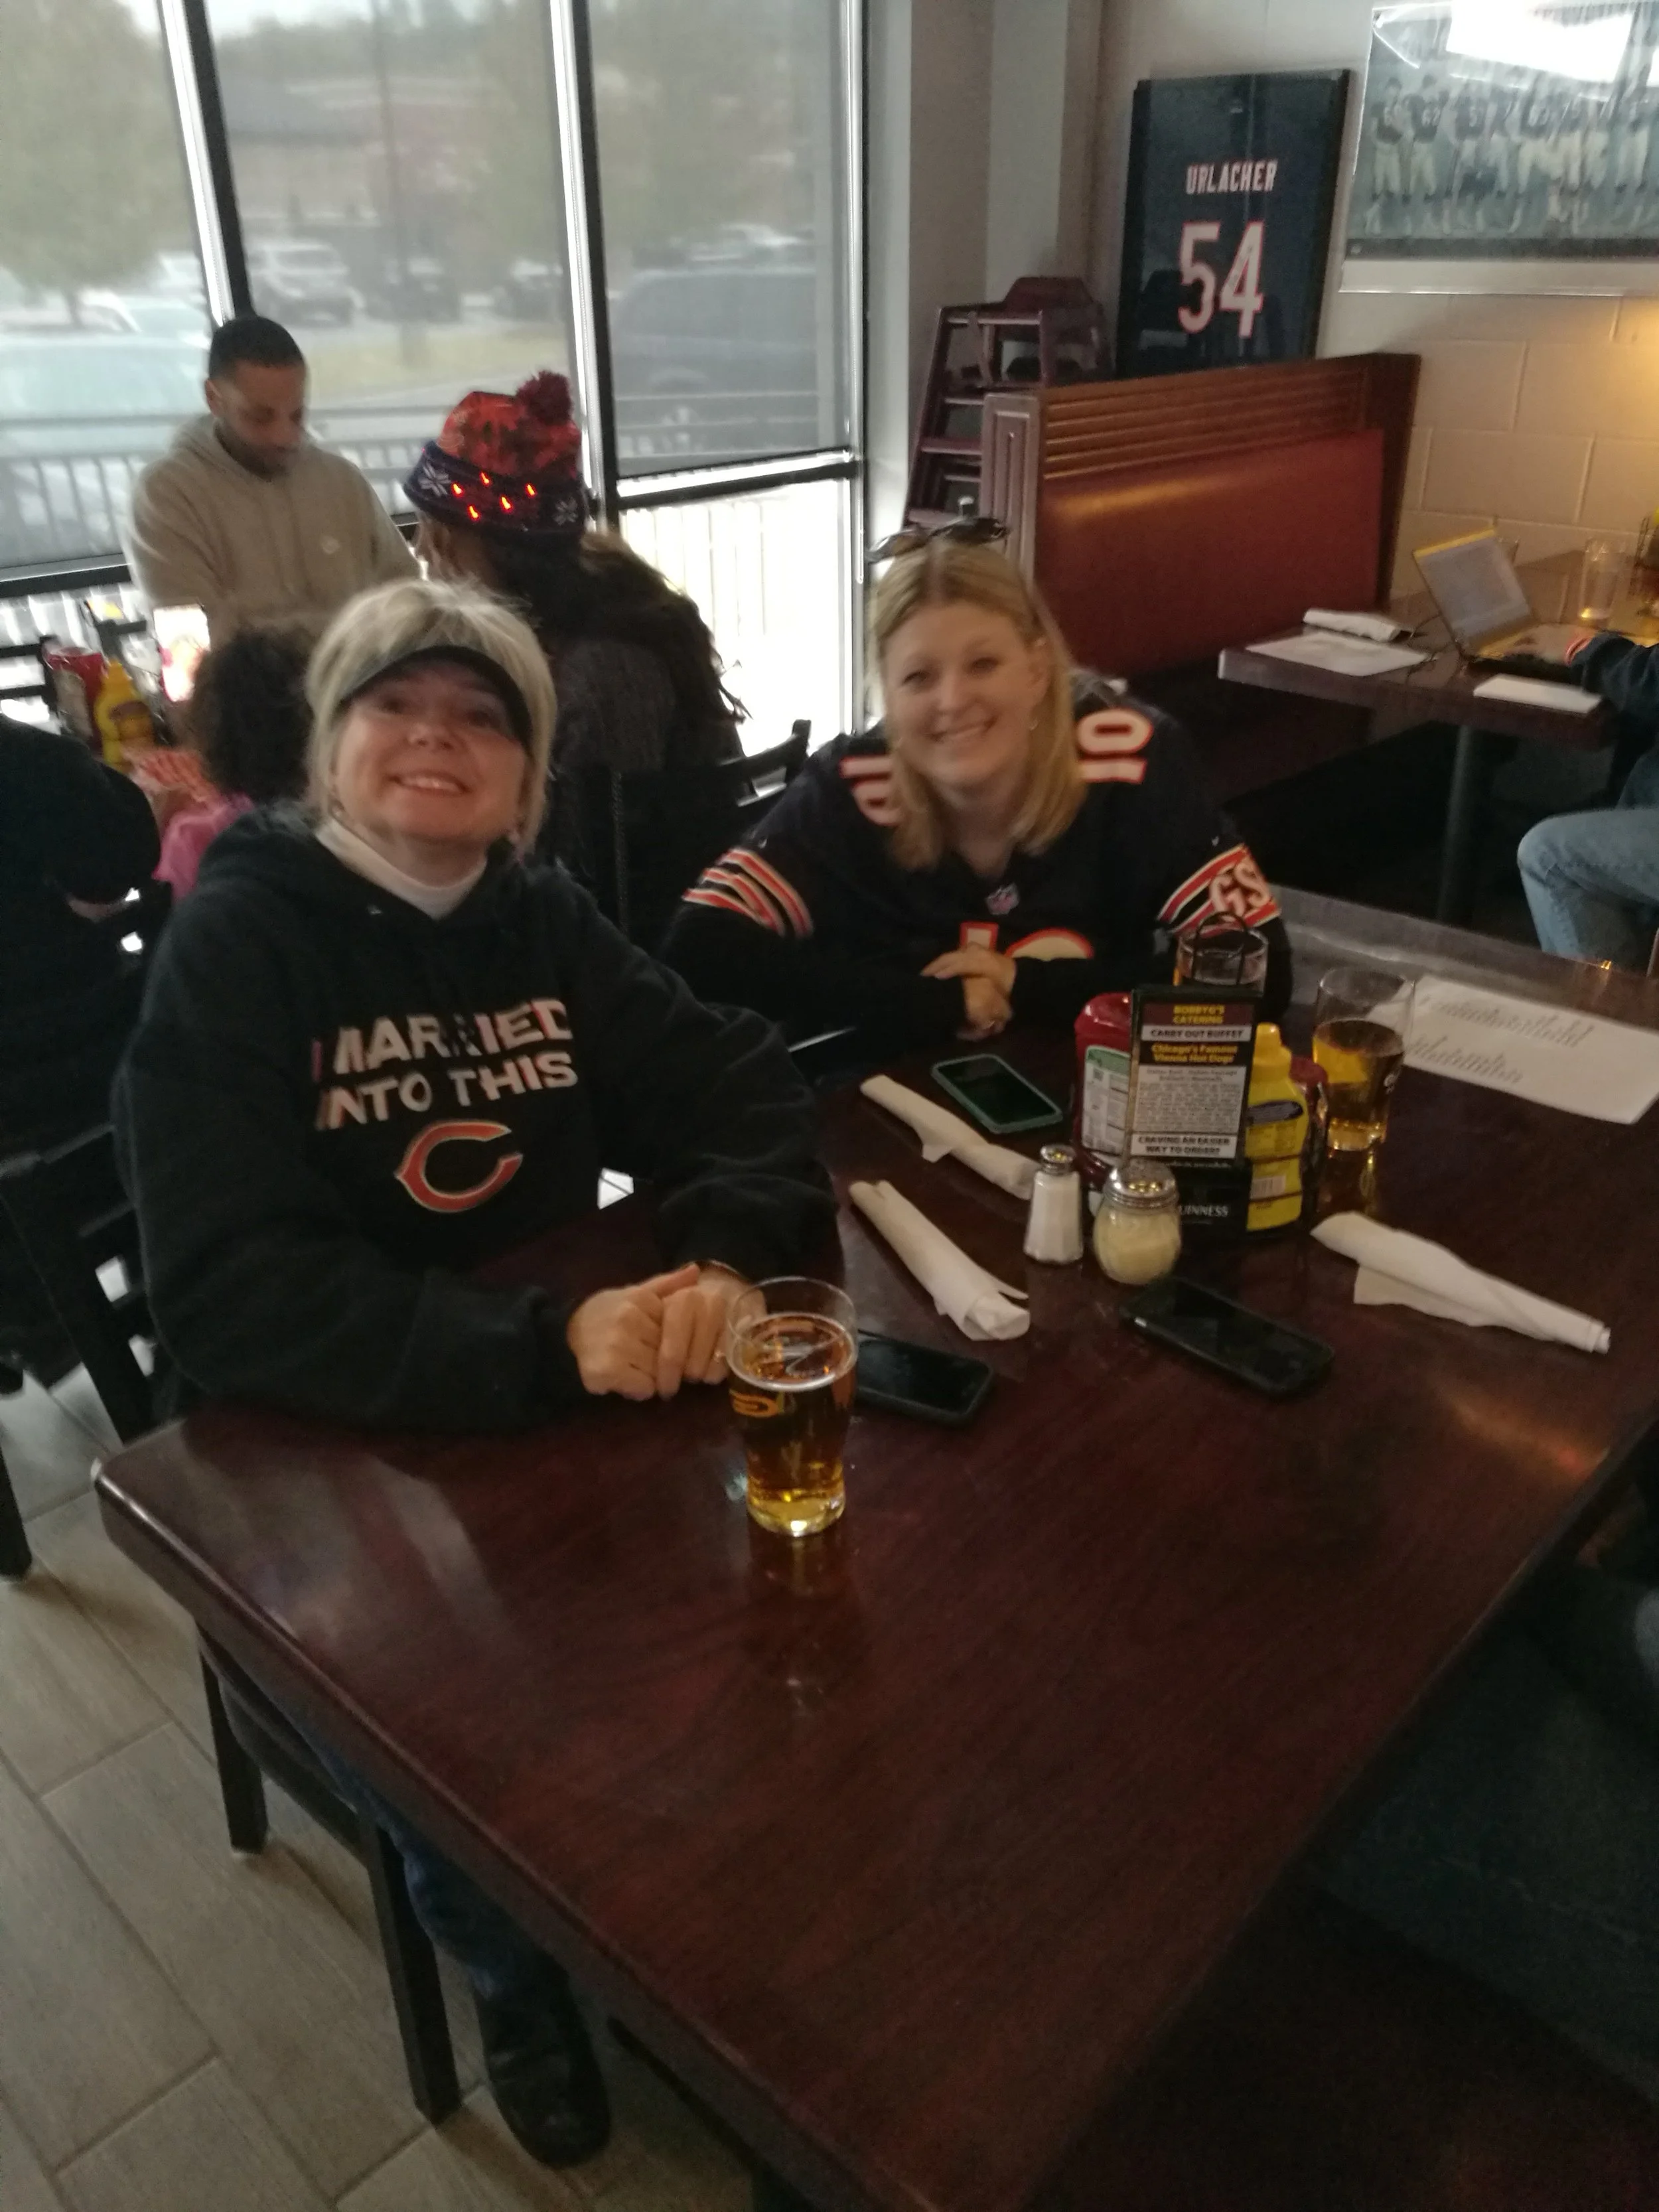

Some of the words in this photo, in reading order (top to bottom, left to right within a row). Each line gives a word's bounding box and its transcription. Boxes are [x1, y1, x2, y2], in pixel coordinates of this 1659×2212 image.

[1186, 158, 1279, 195] URLACHER
[1178, 220, 1264, 338] 54
[1206, 1029, 1244, 1038] BUFFET
[447, 1051, 579, 1107] THIS
[1138, 1136, 1181, 1144] CRAVING
[394, 1118, 524, 1213] C
[1179, 1205, 1228, 1217] UINNESS
